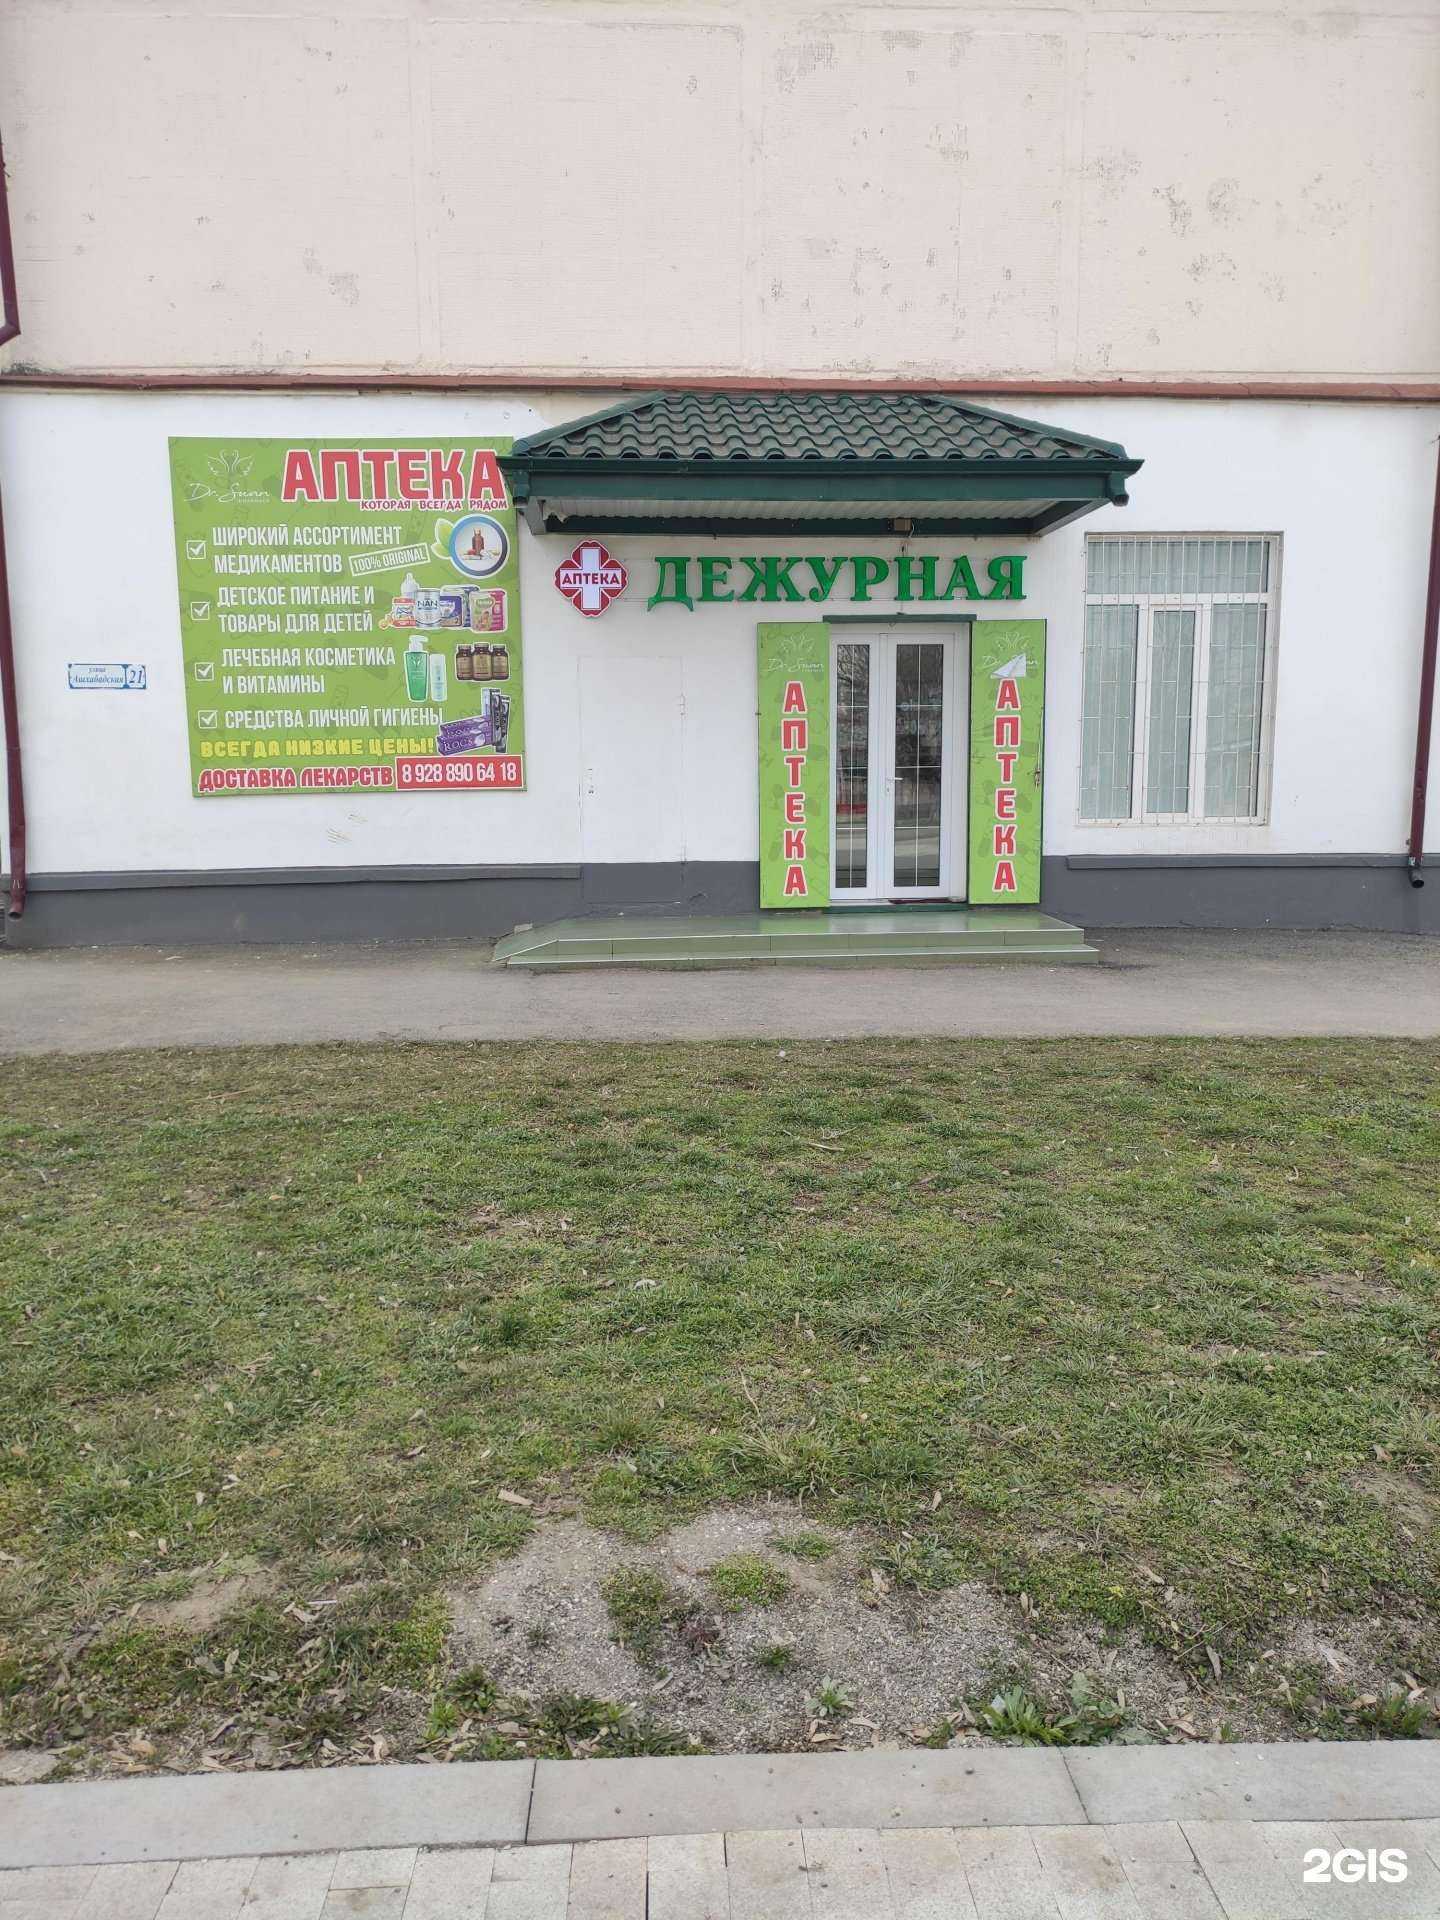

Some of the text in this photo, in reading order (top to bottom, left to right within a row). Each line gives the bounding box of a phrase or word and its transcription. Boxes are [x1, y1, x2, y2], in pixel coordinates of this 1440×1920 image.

[281, 449, 507, 502] АПТЕКА
[360, 498, 508, 511] КОТОРАЯ ВСЕГДА РЯДОМ
[212, 524, 402, 546] ШИРОКИЙ АССОРТИМЕНТ
[214, 554, 343, 575] МЕДИКАМЕНТОВ
[352, 549, 428, 573] 100% ORIGINAL
[562, 573, 622, 586] АПТЕКА
[647, 555, 1027, 612] ДЕЖУРНАЯ
[217, 586, 375, 608] ДЕТСКОЕ ПИТАНИЕ И
[220, 614, 281, 633] ТОВАРЫ
[285, 614, 320, 634] ДЛЯ
[324, 611, 373, 634] ДЕТЕЙ
[221, 647, 396, 668] ЛЕЧЕБНАЯ КОСМЕТИКА
[129, 670, 143, 684] 21
[222, 675, 325, 694] И ВИТАМИНЫ
[224, 704, 443, 730] СРЕДСТВА ЛИЧНОЙ ГИГИЕНЫ
[200, 738, 434, 759] ВСЕГДА НИЗКИЕ ЦЕНЫ!
[199, 766, 394, 793] ДОСТАВКА ЛЕКАРСТВ
[402, 762, 517, 783] 8 928 890 64 18
[781, 680, 808, 897] АПТЕКА
[993, 677, 1021, 892] АПТЕКА
